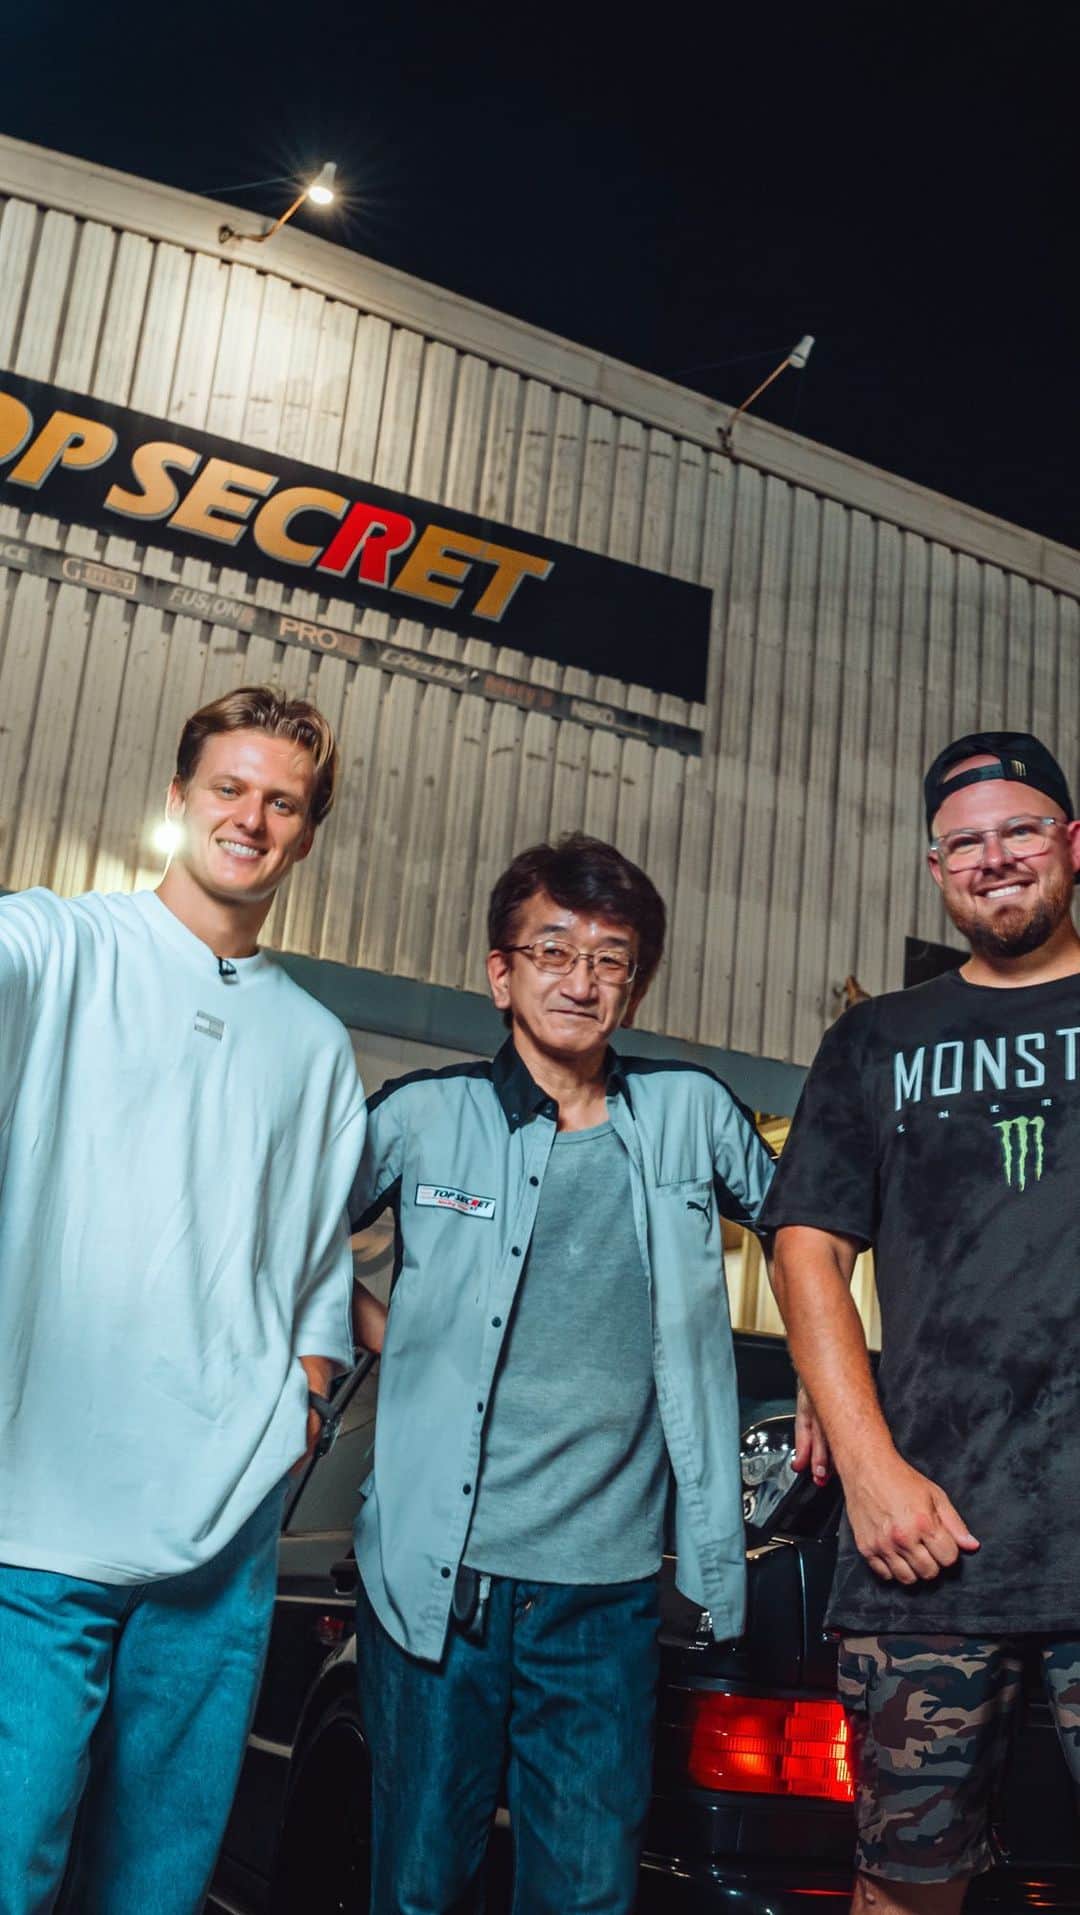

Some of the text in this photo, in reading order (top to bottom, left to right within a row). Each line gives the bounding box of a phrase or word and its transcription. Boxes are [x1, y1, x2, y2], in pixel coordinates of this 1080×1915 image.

[103, 441, 555, 622] SECRET
[894, 1027, 1080, 1111] MONST
[433, 1189, 455, 1199] TOP
[455, 1194, 492, 1209] SECRET
